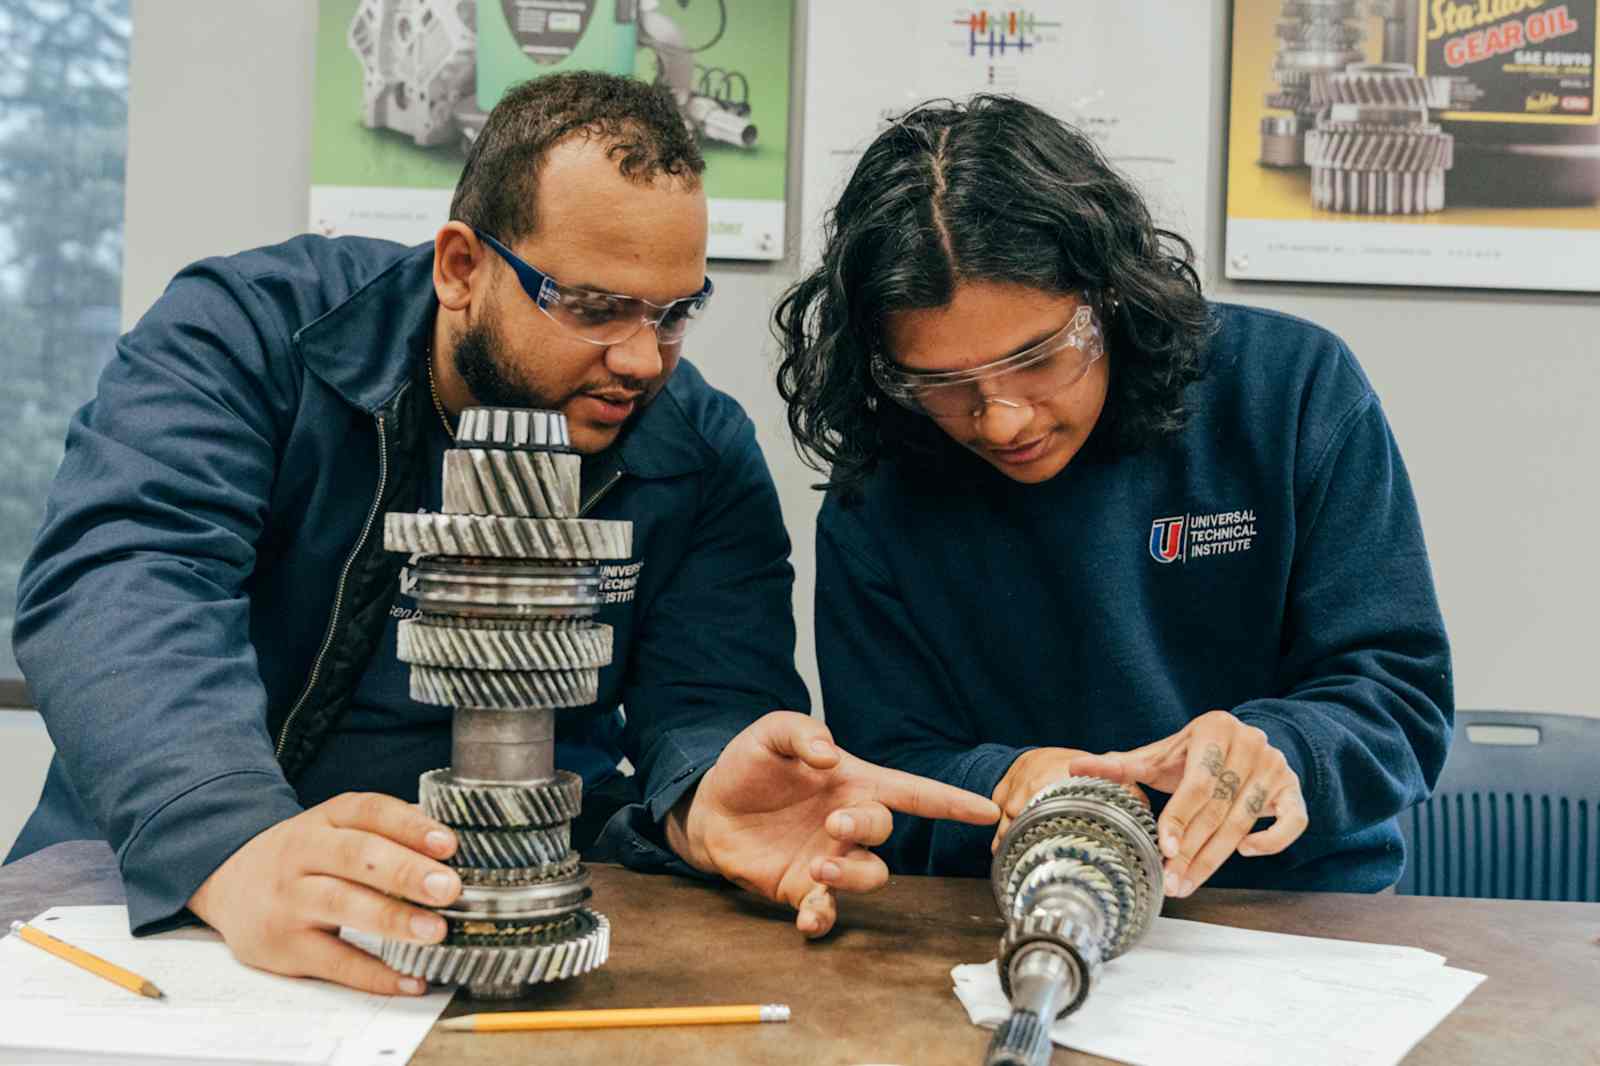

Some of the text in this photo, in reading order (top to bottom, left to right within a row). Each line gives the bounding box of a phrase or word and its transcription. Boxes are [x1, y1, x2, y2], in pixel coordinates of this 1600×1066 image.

[1444, 5, 1578, 68] GEAR OIL
[1514, 51, 1543, 64] SAE
[1190, 509, 1257, 528] UNIVERSAL
[1190, 523, 1257, 542] TECHNICAL
[1191, 538, 1252, 558] INSTITUTE
